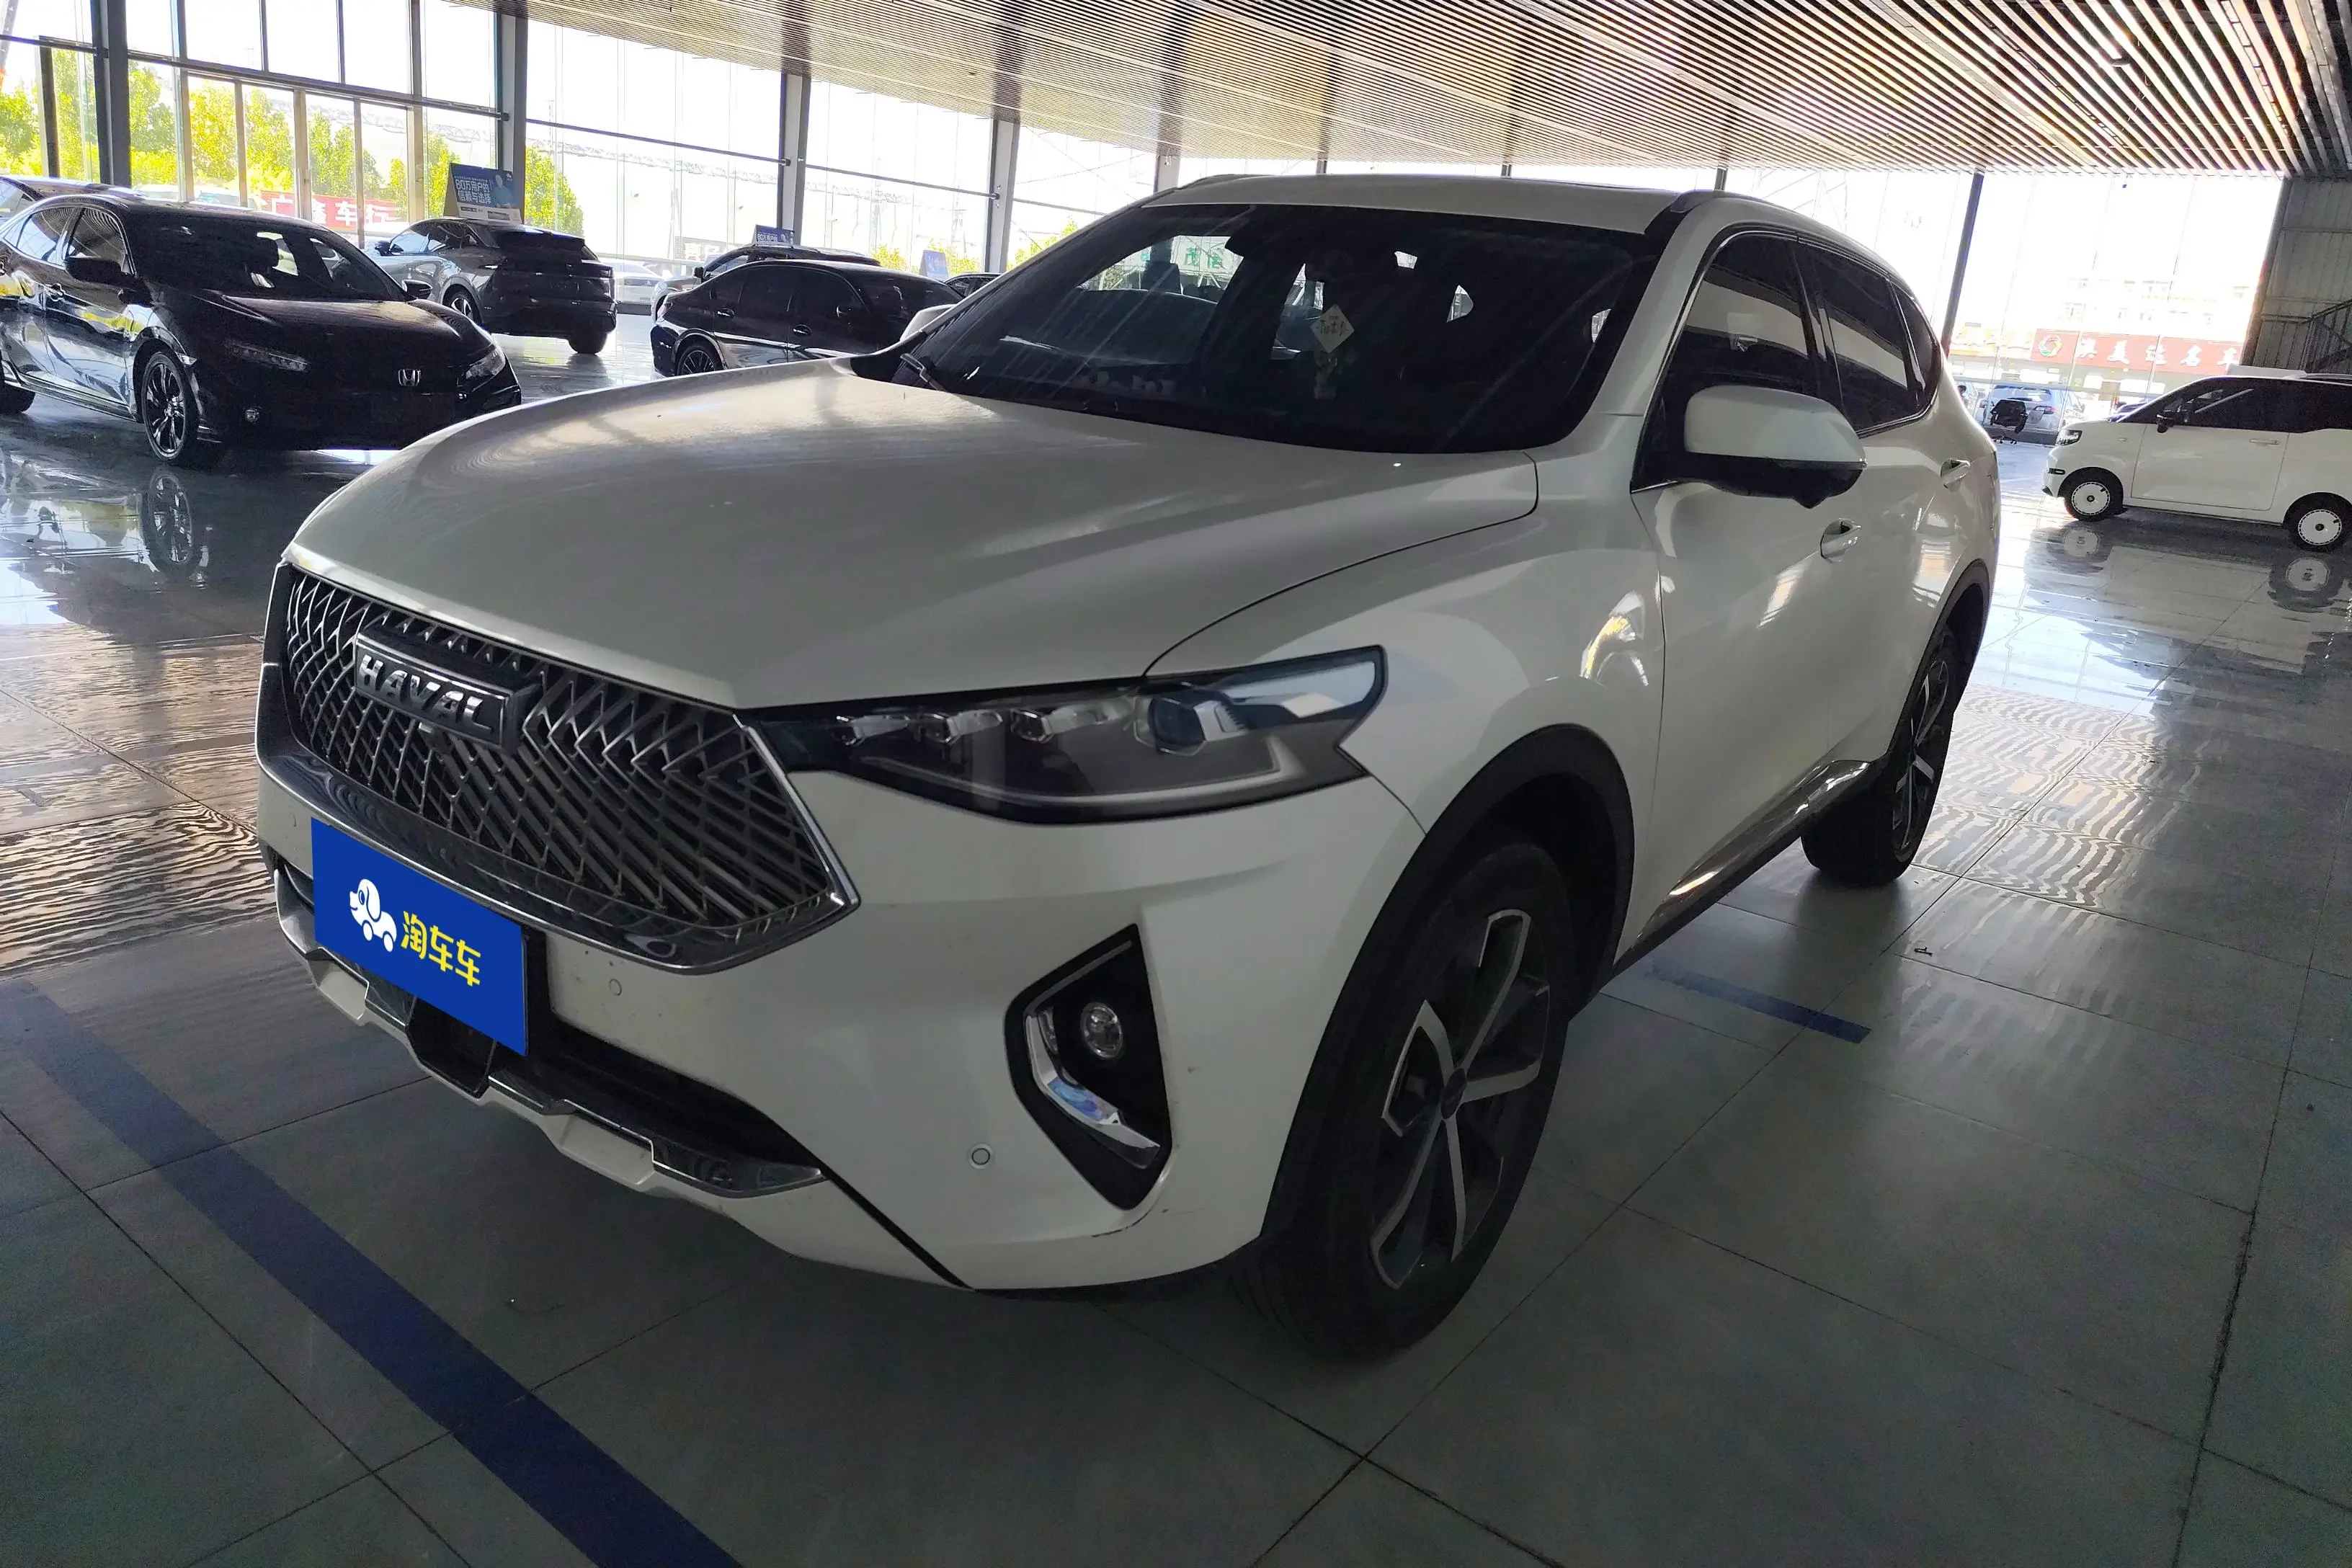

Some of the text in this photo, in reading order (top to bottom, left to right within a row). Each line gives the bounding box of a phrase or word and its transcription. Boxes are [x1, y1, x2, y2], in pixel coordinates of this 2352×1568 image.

[455, 179, 490, 193] 80万用户的
[359, 654, 493, 734] HAVAL
